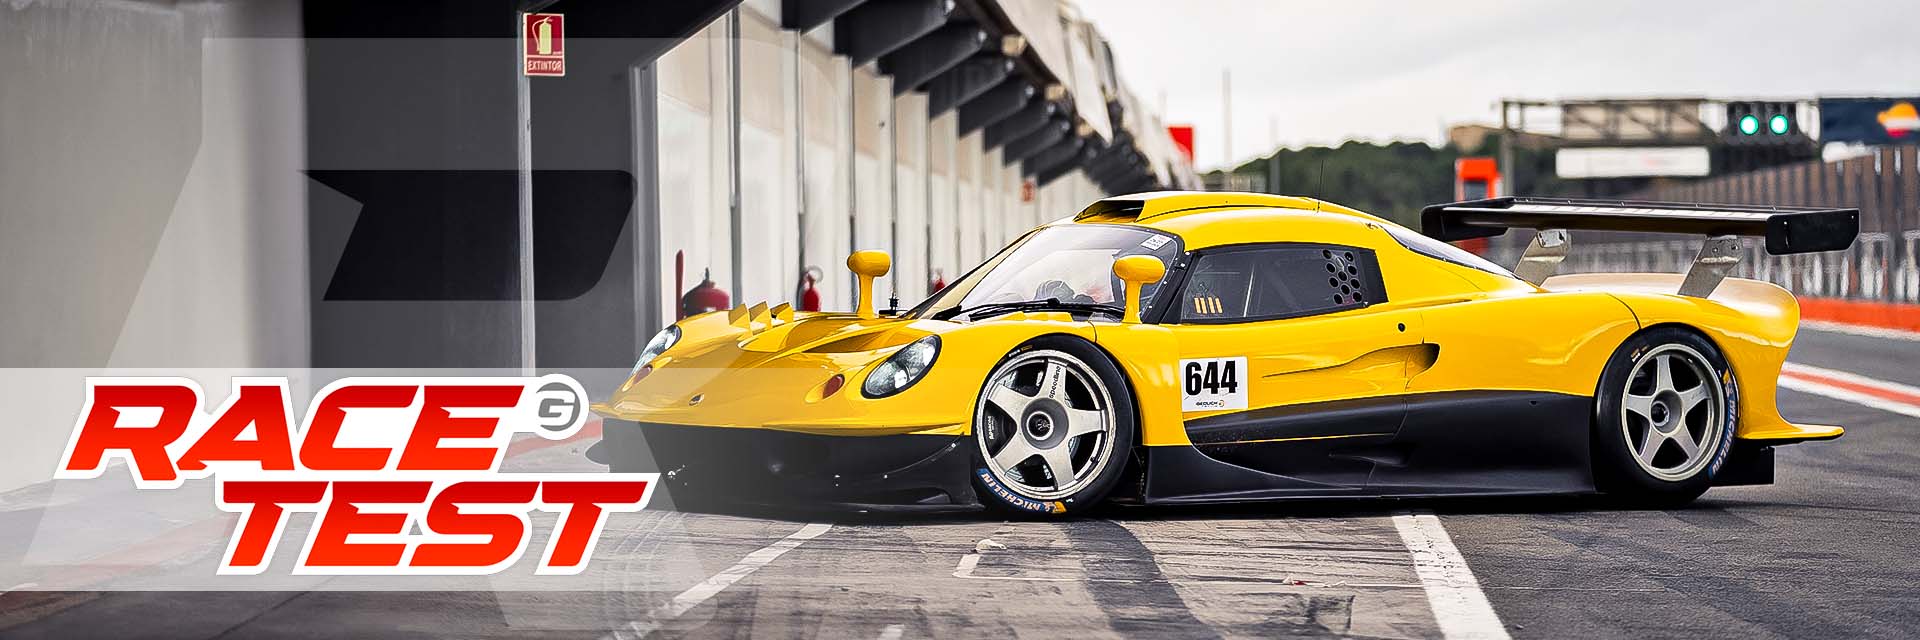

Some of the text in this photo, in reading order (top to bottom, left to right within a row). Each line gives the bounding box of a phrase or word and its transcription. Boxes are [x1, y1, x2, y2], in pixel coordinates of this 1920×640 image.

[527, 60, 562, 72] EXTINTOR
[1185, 360, 1238, 396] 644
[1712, 399, 1737, 475] MICHELIN
[981, 472, 1041, 511] MICHELIN
